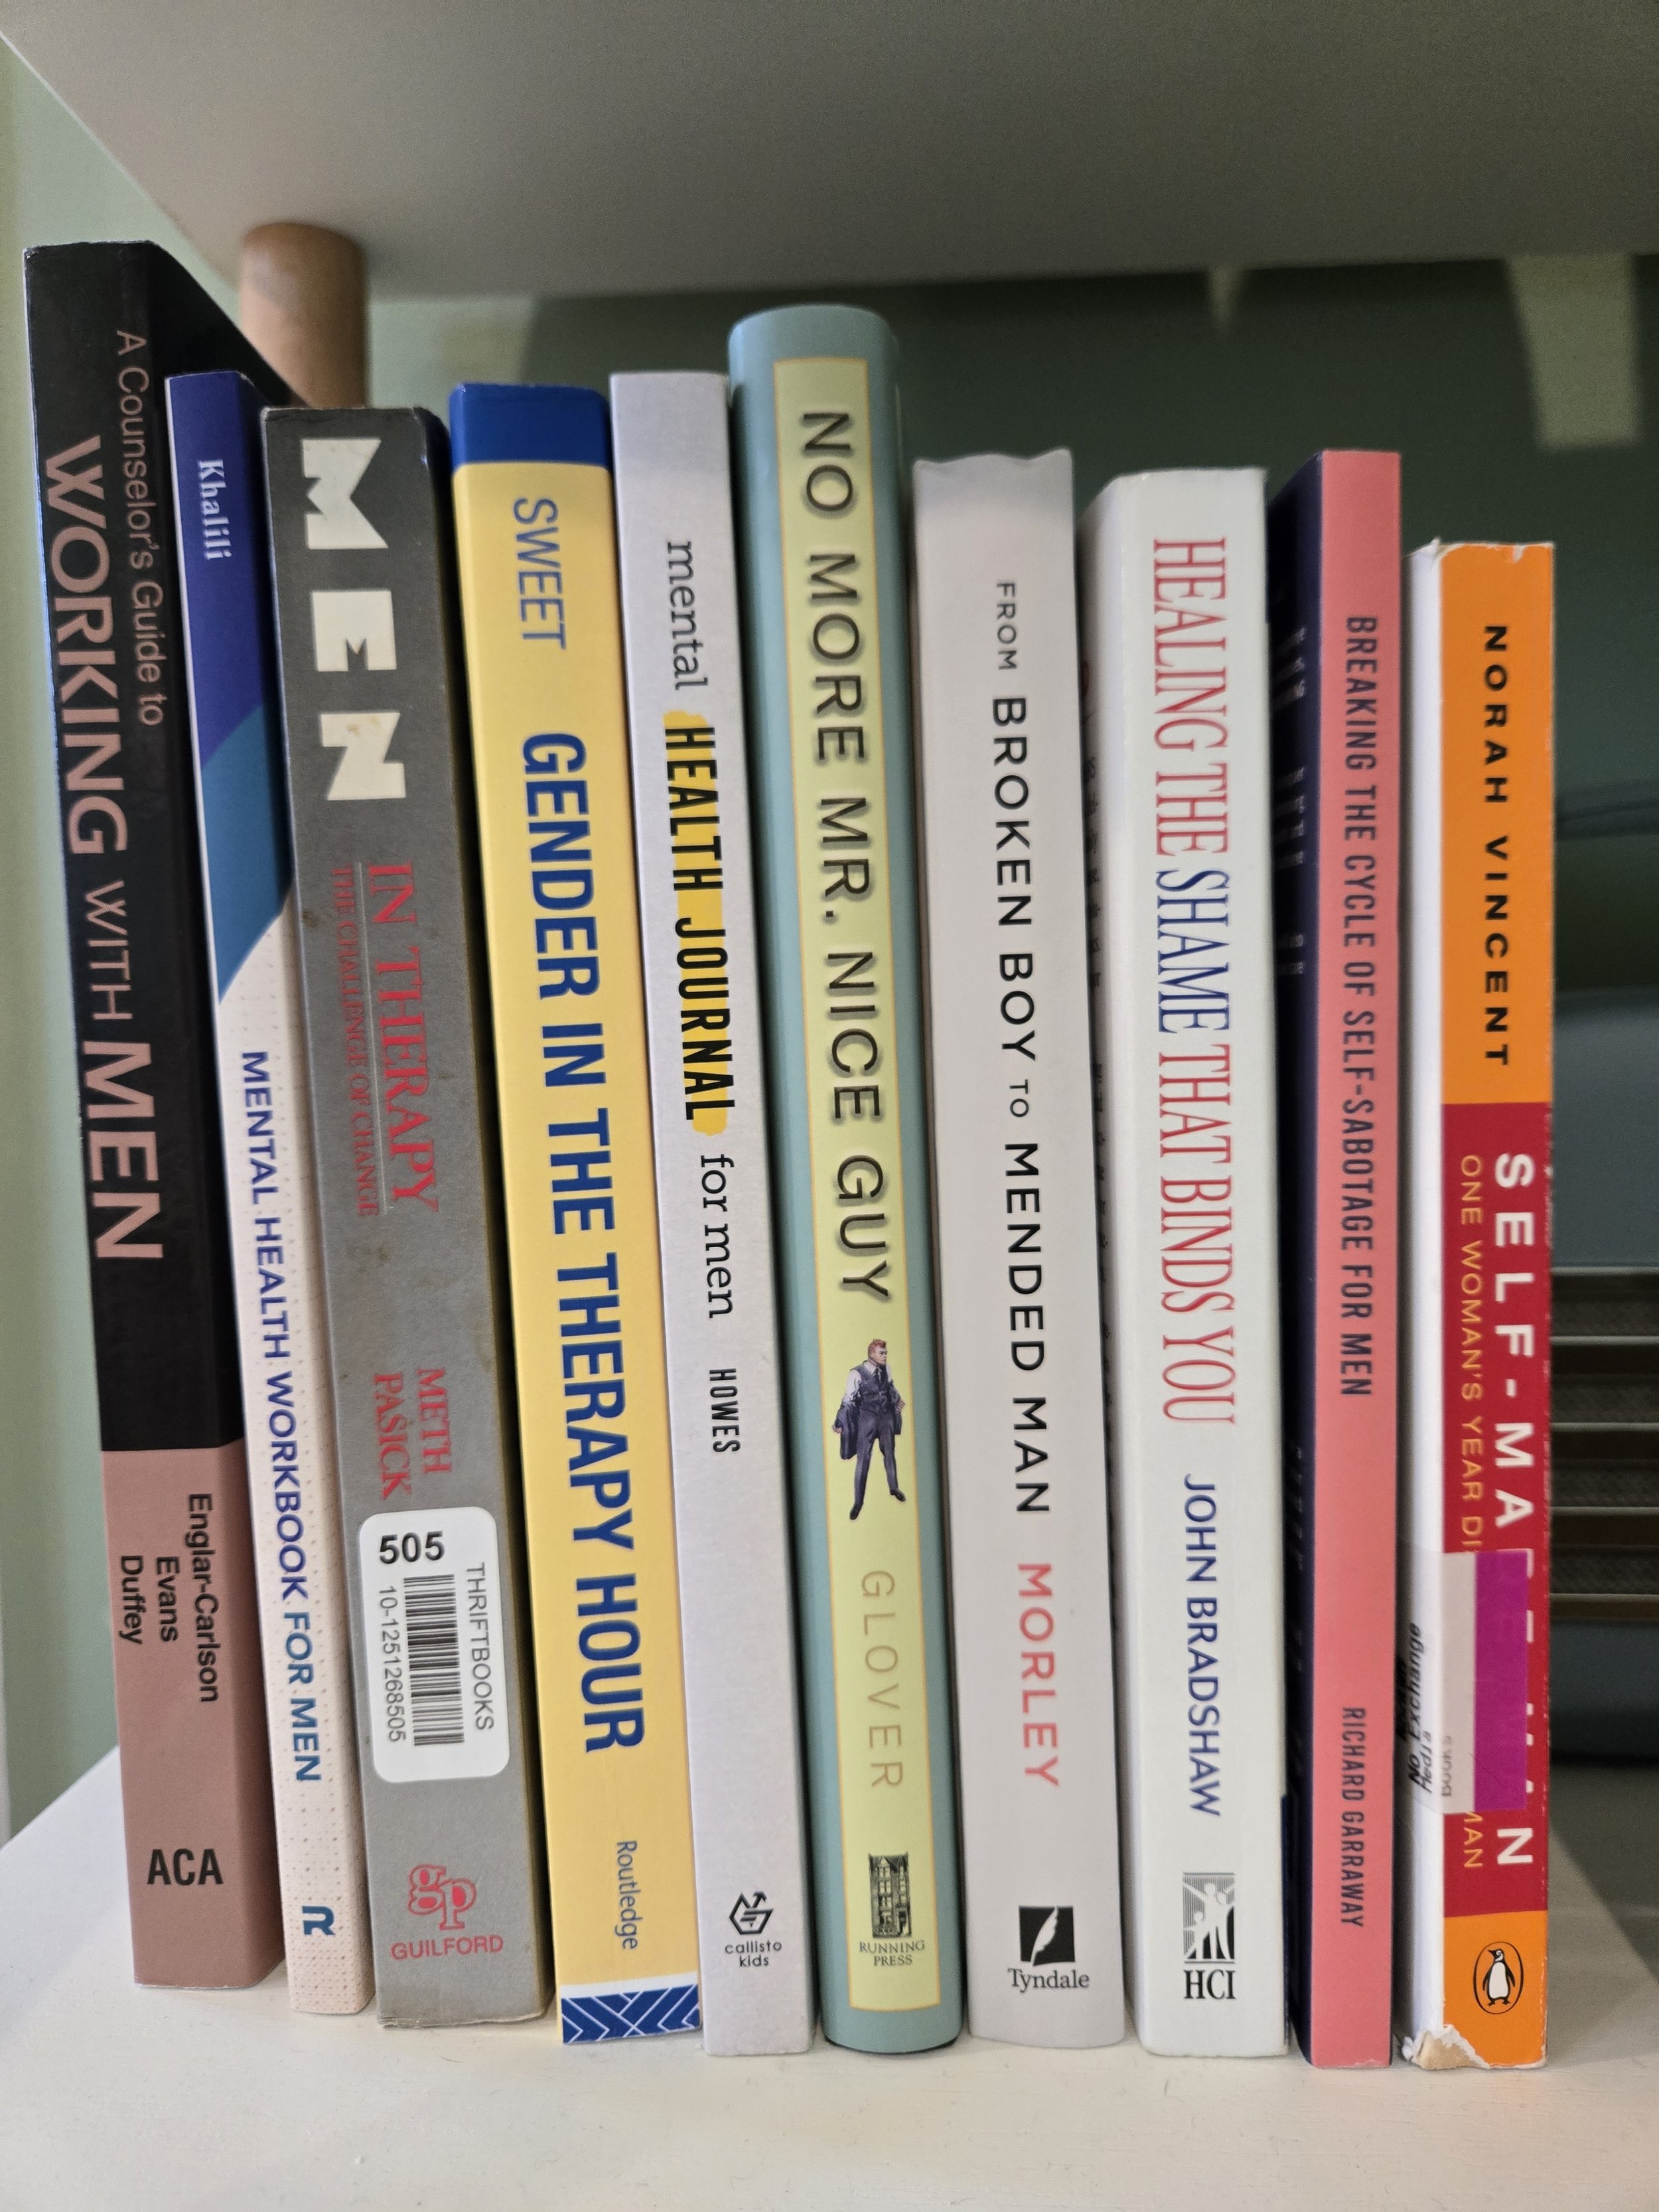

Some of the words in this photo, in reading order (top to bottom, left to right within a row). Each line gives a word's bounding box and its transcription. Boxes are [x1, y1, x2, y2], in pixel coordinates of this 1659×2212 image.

[117, 331, 147, 356] A
[118, 367, 160, 569] Counselor's
[198, 459, 232, 560] Khalili
[802, 411, 854, 513] NO
[301, 438, 406, 801] MEN
[513, 498, 567, 650] SWEET
[668, 539, 708, 691] mental
[996, 581, 1018, 670] FROM
[46, 435, 127, 854] WORKING
[133, 581, 168, 684] Guide
[809, 552, 865, 763] MORE
[1153, 537, 1228, 753] HEALING
[137, 694, 168, 726] to
[1344, 616, 1377, 771] BREAKING
[1483, 625, 1509, 804] NORAH
[665, 727, 723, 891] HEALTH
[820, 797, 870, 919] MR.
[992, 697, 1033, 926] BROKEN
[1155, 763, 1229, 857] THE
[1344, 784, 1376, 842] THE
[332, 864, 355, 916] THE
[368, 862, 417, 924] IN
[522, 733, 600, 1000] GENDER
[1344, 854, 1376, 948] CYCLE
[86, 880, 133, 1020] WITH
[338, 920, 369, 1067] CHALLENGE
[999, 952, 1037, 1062] BOY
[1155, 869, 1230, 1034] SHAME
[1343, 961, 1375, 997] OF
[1484, 835, 1509, 1065] VINCENT
[542, 1023, 607, 1087] IN
[675, 917, 736, 1120] JOURNAL
[827, 951, 881, 1120] NICE
[242, 1051, 281, 1204] MENTAL
[349, 1072, 370, 1106] OF
[376, 944, 439, 1213] THERAPY
[1009, 1078, 1030, 1118] TO
[1158, 1043, 1231, 1164] THAT
[1340, 1009, 1374, 1251] SELF-SABOTAGE
[83, 1041, 164, 1258] MEN
[352, 1112, 379, 1216] CHANGE
[547, 1108, 614, 1234] THE
[701, 1153, 735, 1212] for
[1461, 1154, 1483, 1226] ONE
[705, 1224, 735, 1318] men
[837, 1154, 889, 1299] GUY
[1005, 1143, 1046, 1372] MENDED
[1160, 1176, 1235, 1313] BINDS
[254, 1217, 291, 1359] HEALTH
[1340, 1265, 1373, 1320] FOR
[1461, 1239, 1484, 1402] WOMAN'S
[417, 1367, 453, 1475] METH
[557, 1252, 634, 1550] THERAPY
[709, 1368, 741, 1453] HOWES
[1162, 1326, 1236, 1424] YOU
[1340, 1333, 1373, 1396] MEN
[1494, 1152, 1535, 1644] SELF-MA
[267, 1370, 309, 1601] WORKBOOK
[374, 1372, 412, 1500] PASICK
[1013, 1396, 1050, 1514] MAN
[1461, 1416, 1483, 1501] YEAR
[379, 1530, 445, 1564] 505
[1184, 1473, 1218, 1584] JOHN
[119, 1556, 145, 1645] Duffey
[155, 1556, 180, 1643] Evans
[185, 1493, 222, 1703] Englar-Carlson
[284, 1611, 315, 1684] FOR
[467, 1562, 494, 1731] THRIFTBOOKS
[380, 1585, 407, 1743] 10-1251268505
[575, 1573, 645, 1753] HOUR
[861, 1570, 904, 1787] GLOVER
[1017, 1563, 1060, 1789] MORLEY
[1186, 1596, 1221, 1818] BRADSHAW
[1407, 1623, 1424, 1741] Exchange
[291, 1699, 321, 1783] MEN
[1342, 1706, 1366, 1803] RICHARD
[1407, 1753, 1420, 1785] No
[147, 1848, 224, 1885] ACA
[302, 1905, 334, 1937] R
[614, 1840, 645, 1951] Routledge
[1340, 1810, 1366, 1929] GARRAWAY
[392, 1934, 504, 1960] GUILFORD
[725, 1939, 782, 1954] callisto
[739, 1954, 770, 1968] kids
[859, 1939, 926, 1954] RUNNING
[873, 1954, 913, 1967] PRESS
[1007, 1968, 1090, 1992] Tyndale
[1183, 1970, 1236, 2000] HCI
